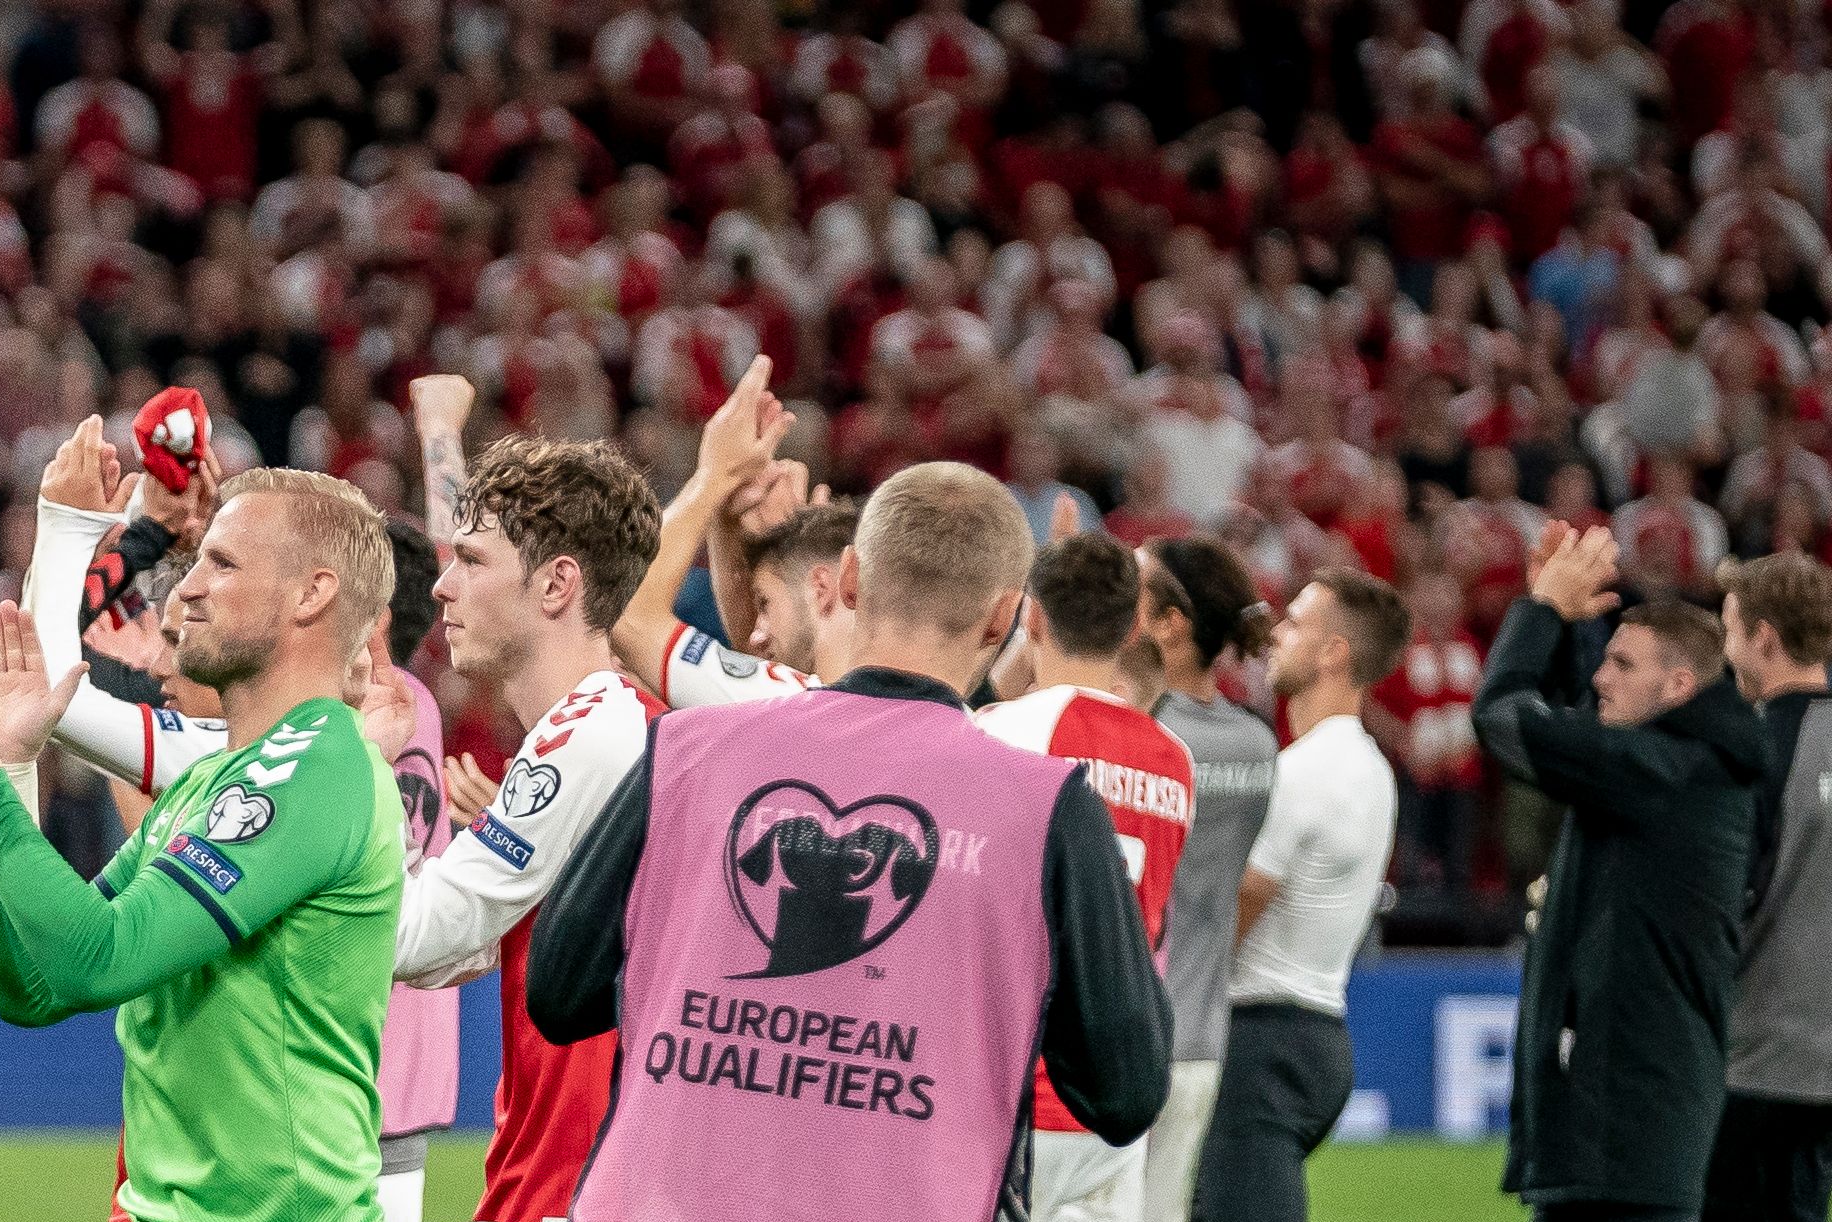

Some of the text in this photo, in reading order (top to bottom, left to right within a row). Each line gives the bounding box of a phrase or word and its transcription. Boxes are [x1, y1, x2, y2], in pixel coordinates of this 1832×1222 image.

[183, 843, 237, 887] RESPECT
[482, 822, 531, 862] RESPECT
[680, 988, 919, 1063] EUROPEAN
[644, 1031, 936, 1121] QUALIFIERS
